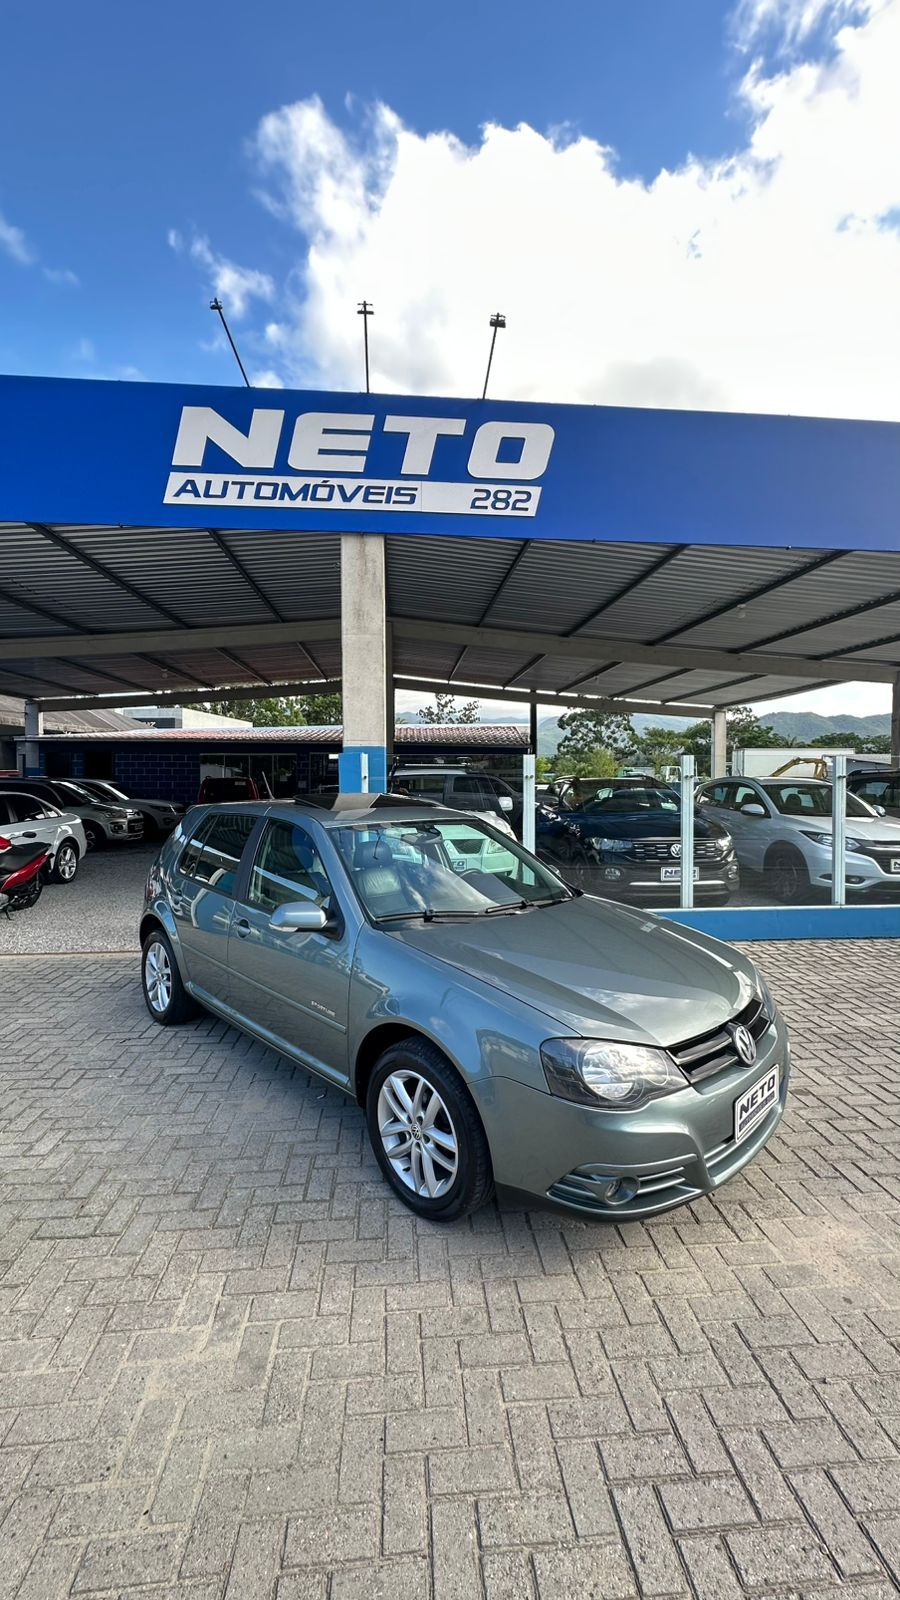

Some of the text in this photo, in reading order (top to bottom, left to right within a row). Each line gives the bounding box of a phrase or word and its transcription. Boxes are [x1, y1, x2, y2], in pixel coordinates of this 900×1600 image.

[172, 406, 555, 480] NETO
[173, 479, 532, 512] AUTOMÓVEIS 282
[739, 1074, 775, 1120] NETO
